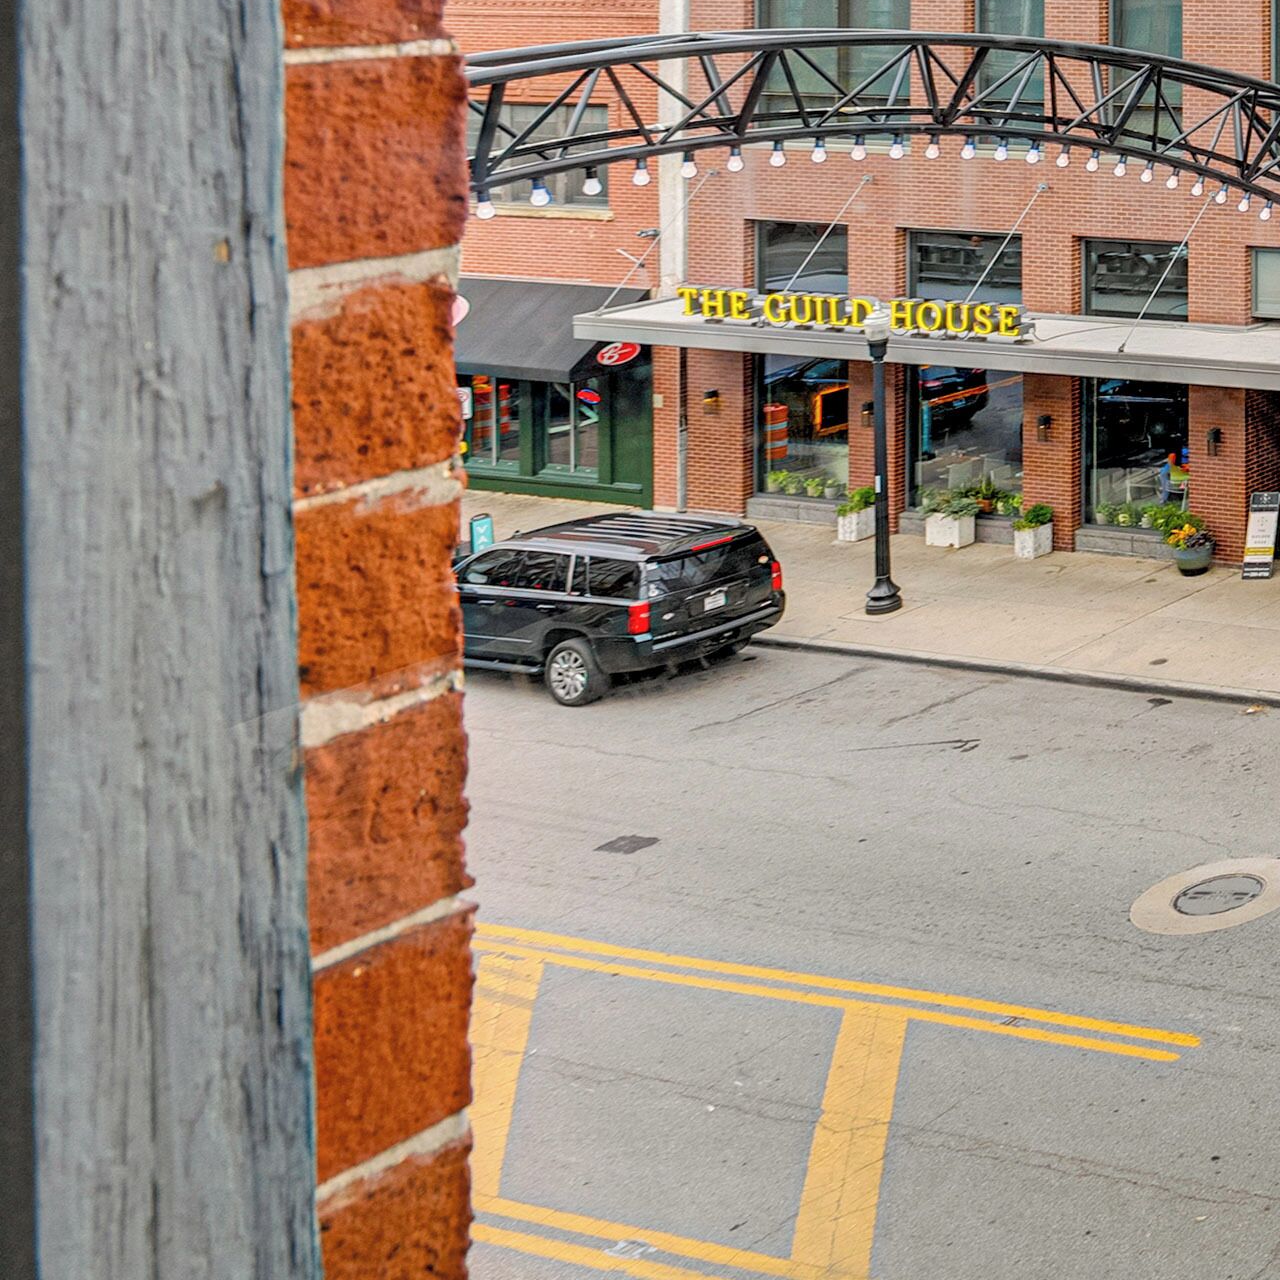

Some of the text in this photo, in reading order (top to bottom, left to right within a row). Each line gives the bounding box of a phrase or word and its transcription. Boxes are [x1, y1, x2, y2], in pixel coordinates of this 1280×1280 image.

[677, 287, 1020, 337] THE GUILD HOUSE
